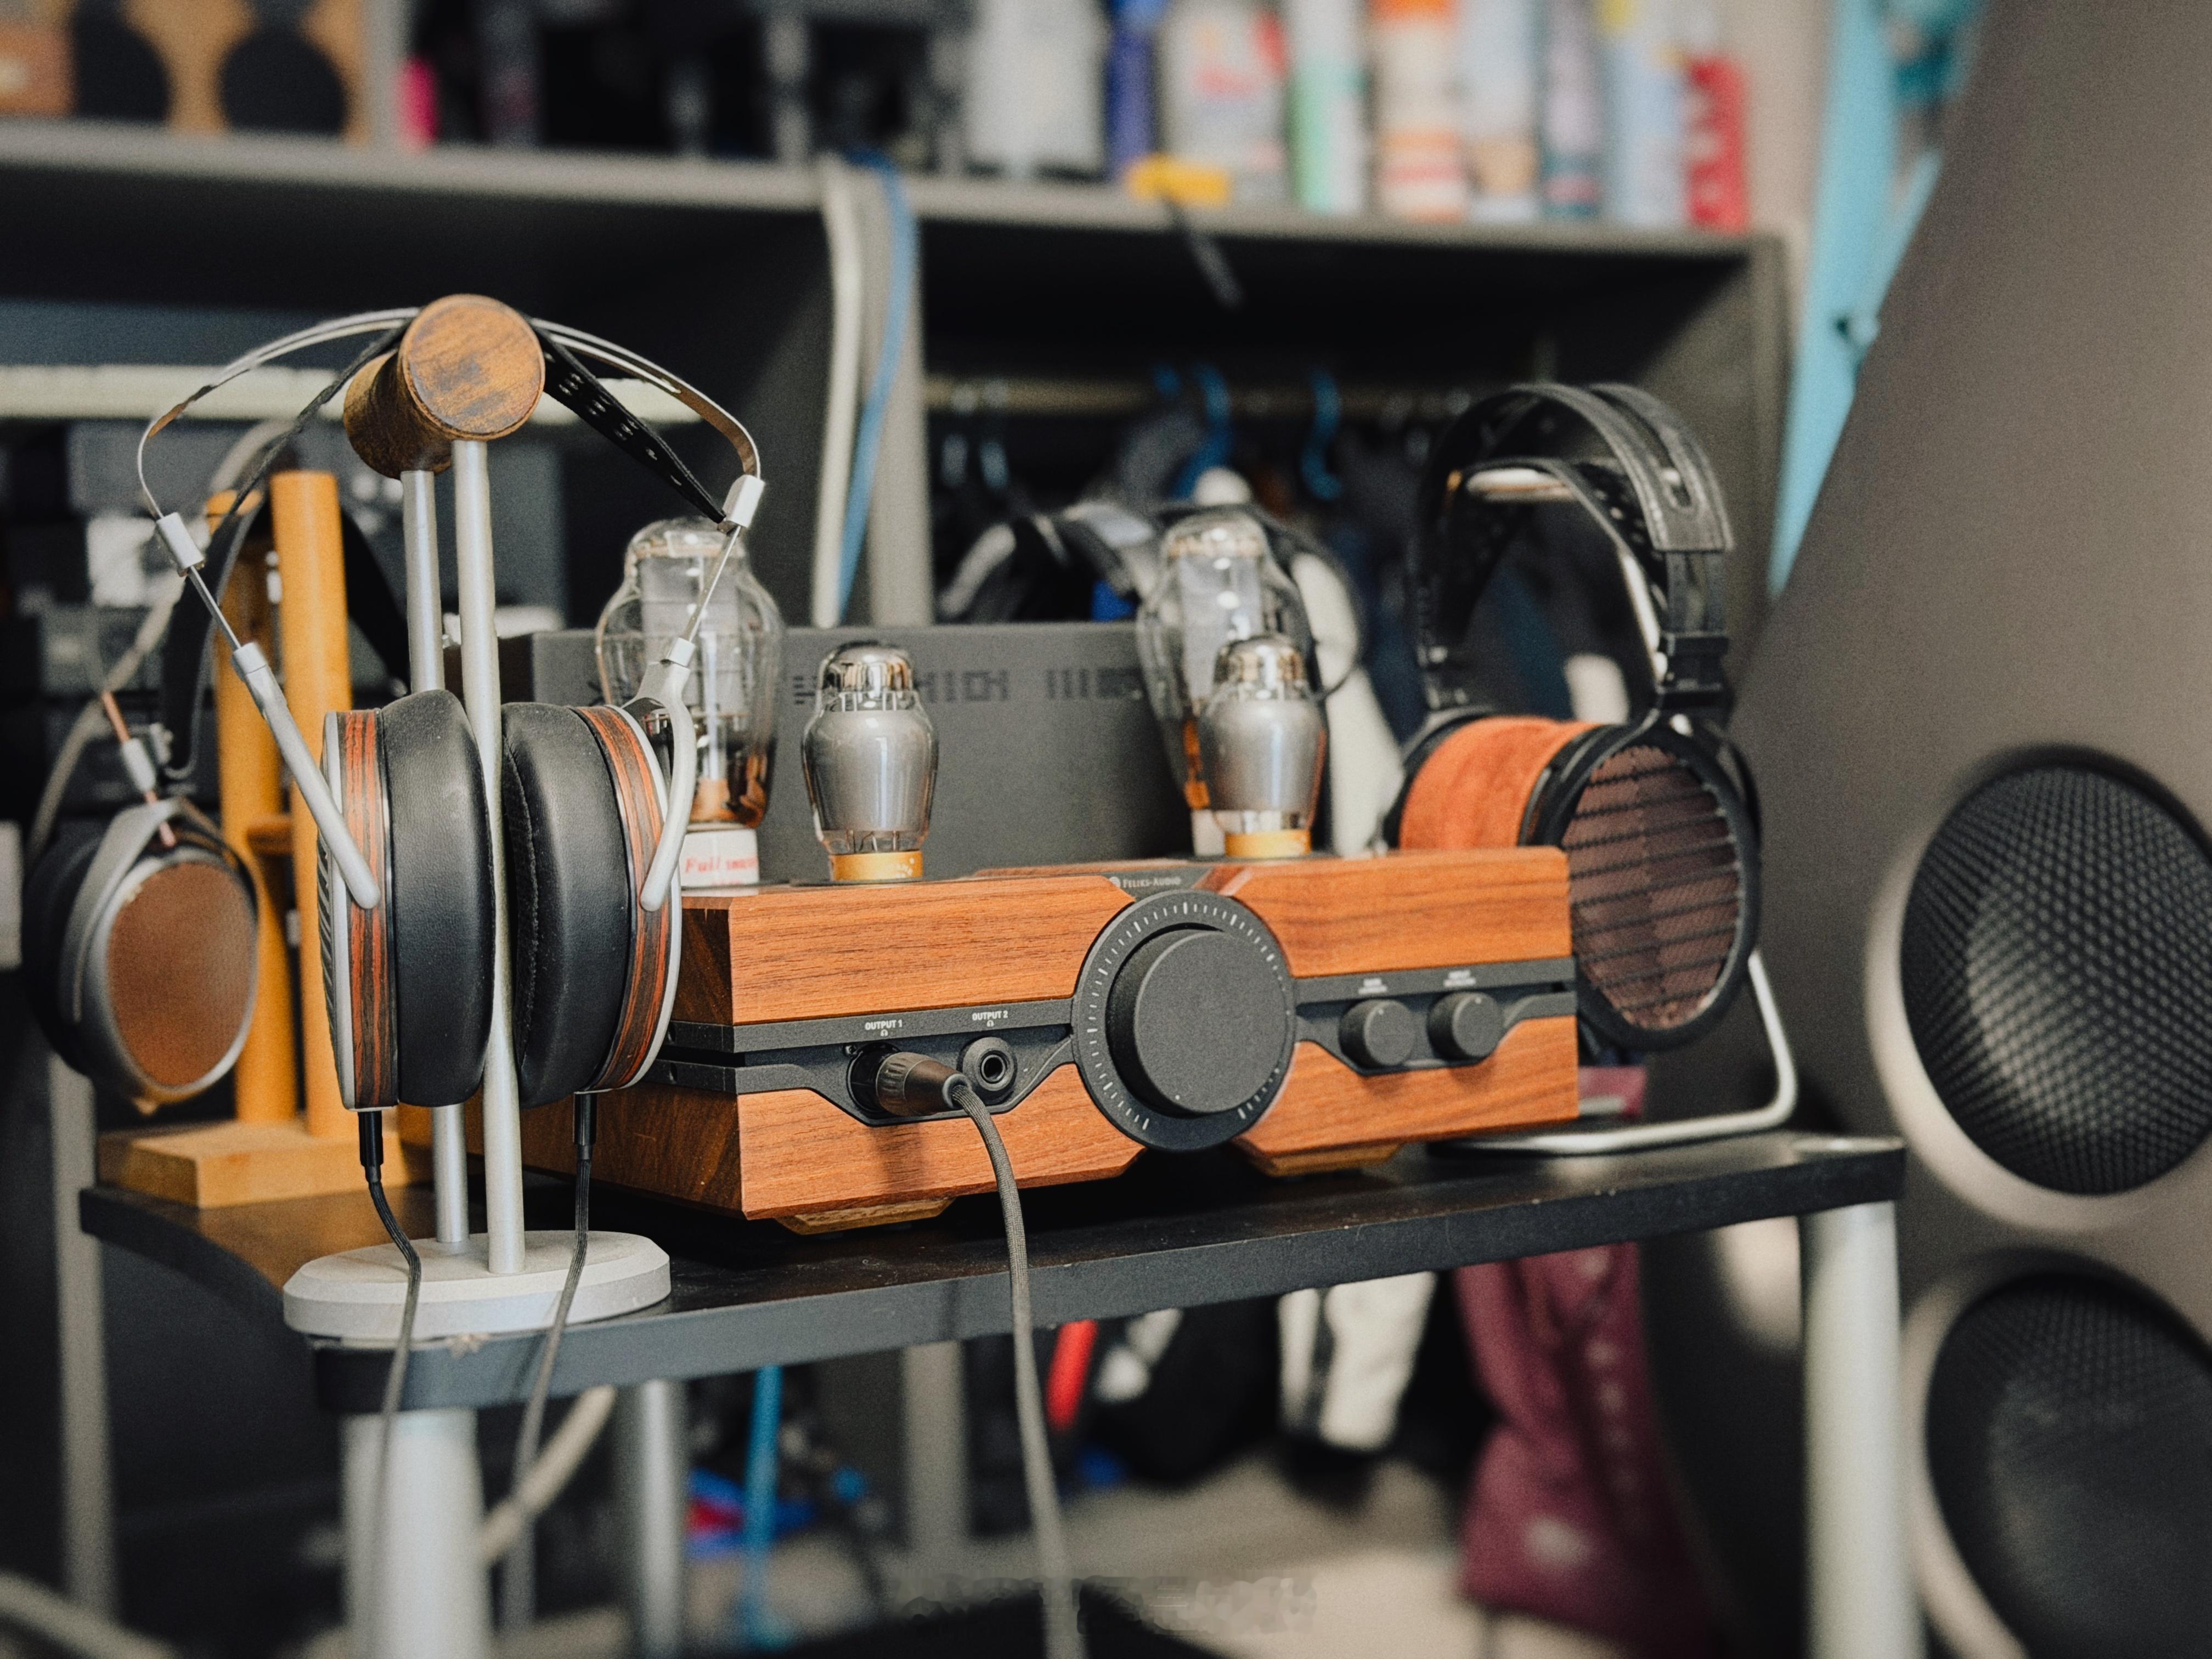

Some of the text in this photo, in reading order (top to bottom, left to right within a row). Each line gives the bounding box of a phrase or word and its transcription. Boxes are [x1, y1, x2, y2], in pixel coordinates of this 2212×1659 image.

[972, 1010, 1008, 1021] OUTPUT 2
[865, 1019, 903, 1030] OUTPUT 1
